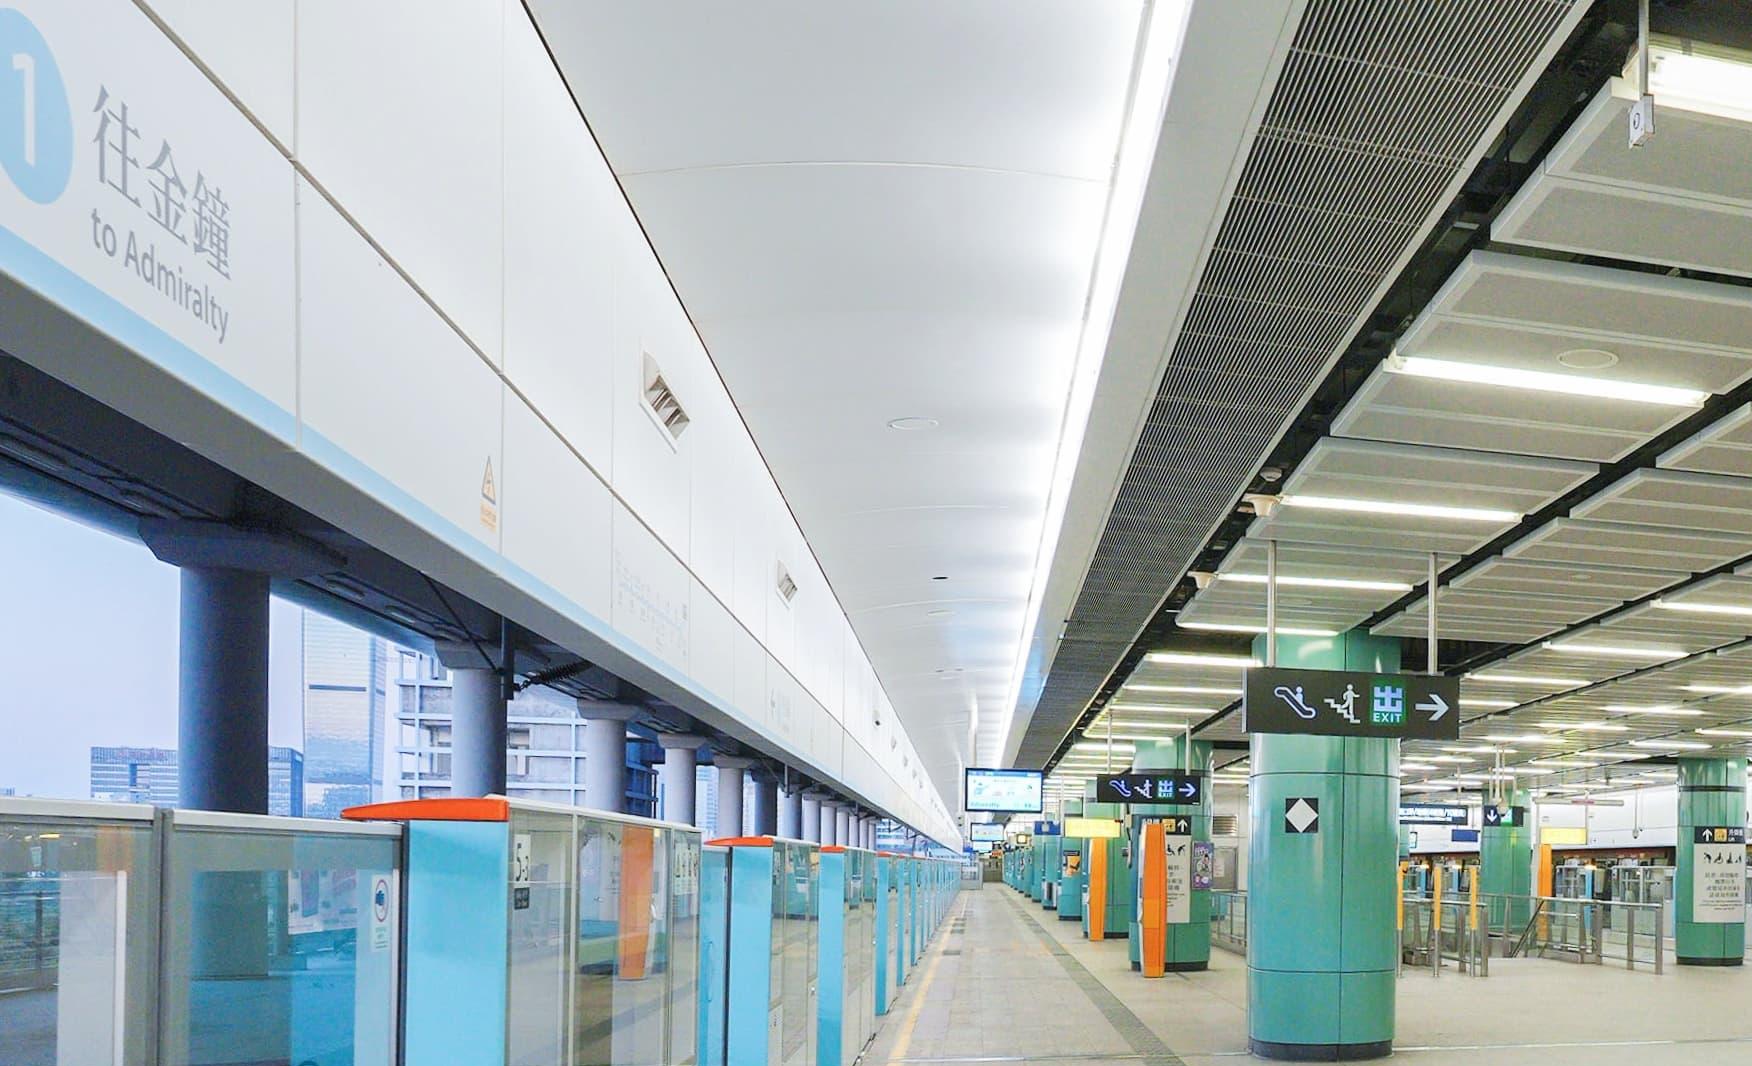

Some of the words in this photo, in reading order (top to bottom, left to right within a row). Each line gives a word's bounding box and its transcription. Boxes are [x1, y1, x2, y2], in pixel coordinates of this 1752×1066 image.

[12, 52, 36, 168] 1
[92, 83, 232, 281] 往金鐘
[91, 207, 117, 258] to
[124, 230, 229, 345] Admiralty
[1372, 712, 1402, 723] EXIT
[1373, 686, 1403, 713] 出
[1158, 780, 1173, 793] 出
[516, 843, 528, 881] 5-3
